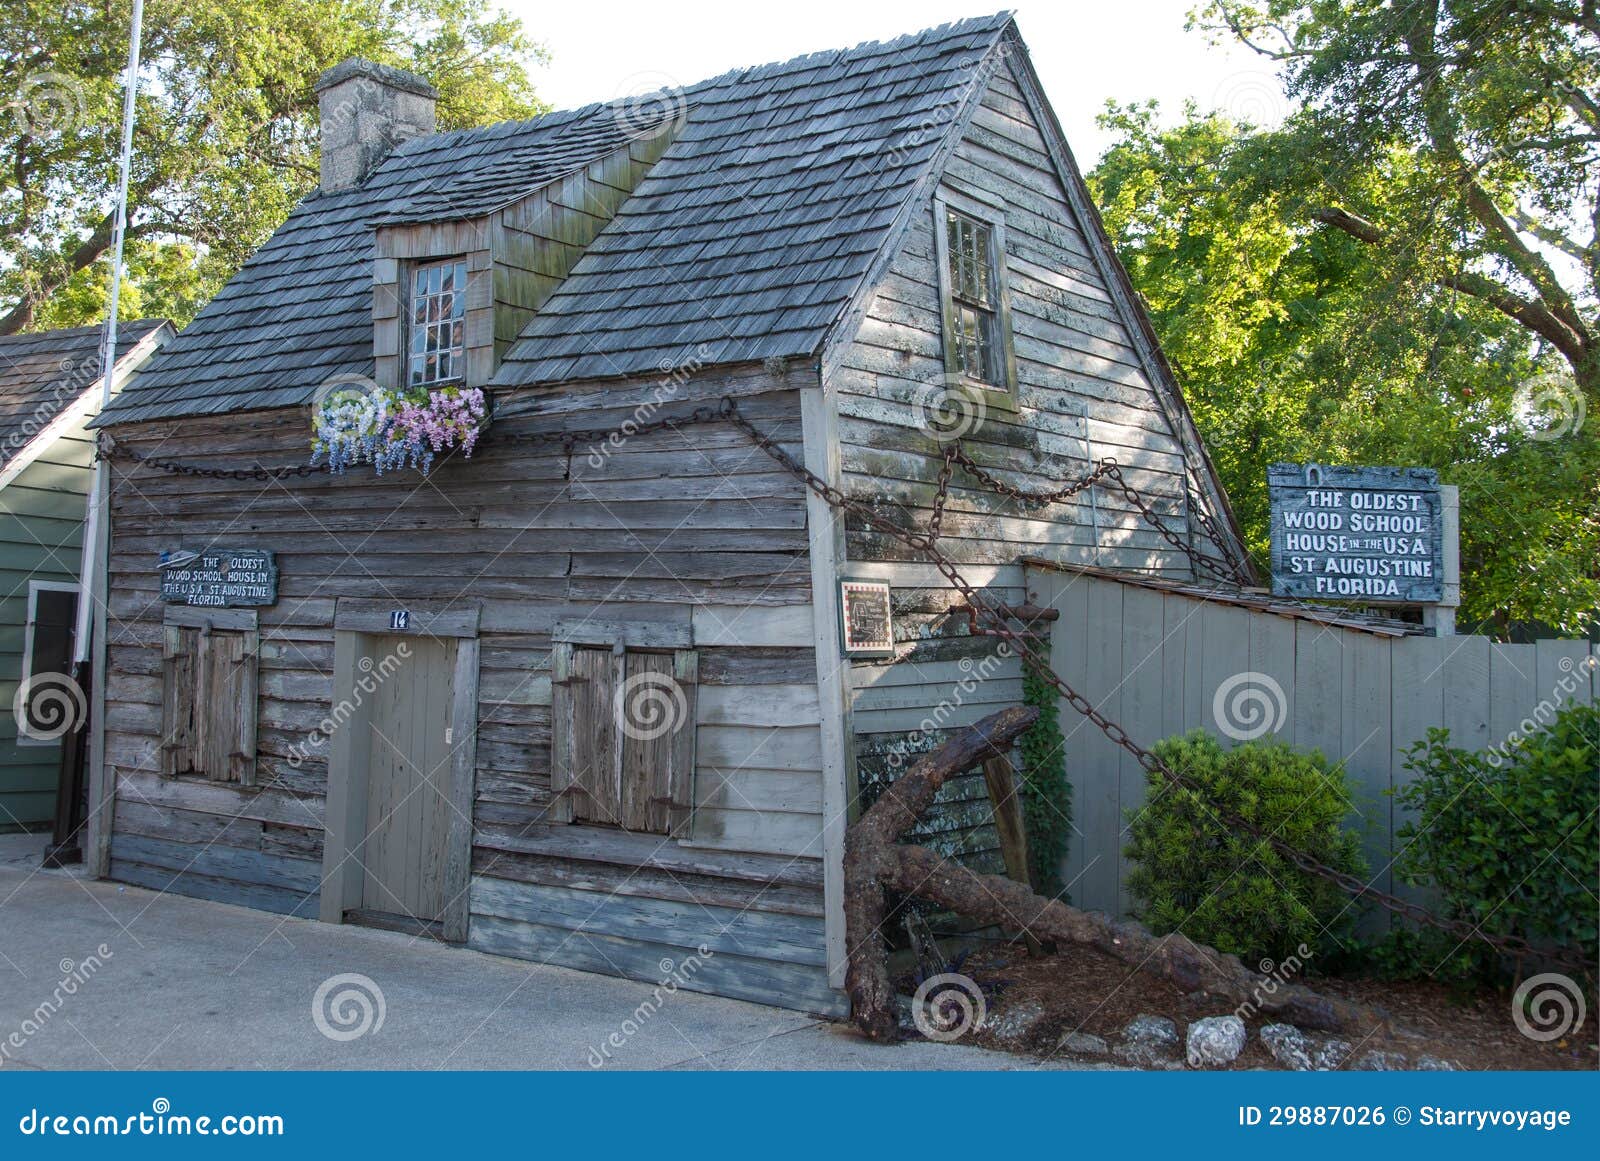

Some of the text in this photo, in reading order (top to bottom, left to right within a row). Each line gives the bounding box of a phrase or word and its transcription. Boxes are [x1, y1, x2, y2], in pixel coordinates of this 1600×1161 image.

[1306, 490, 1421, 511] THE OLDEST
[1283, 511, 1425, 533] WOOD SCHOOL
[1286, 533, 1347, 552] HOUSE
[1349, 539, 1360, 549] IN
[1364, 539, 1382, 550] THE
[203, 558, 265, 569] THE OLDEST
[1290, 556, 1433, 577] ST AUGUSTINE
[167, 570, 268, 583] WOOD SCHOOL HOUSE IN
[164, 583, 180, 593] THE
[1315, 577, 1400, 595] FLORIDA
[187, 594, 226, 605] FLORIDA
[394, 611, 406, 628] 14
